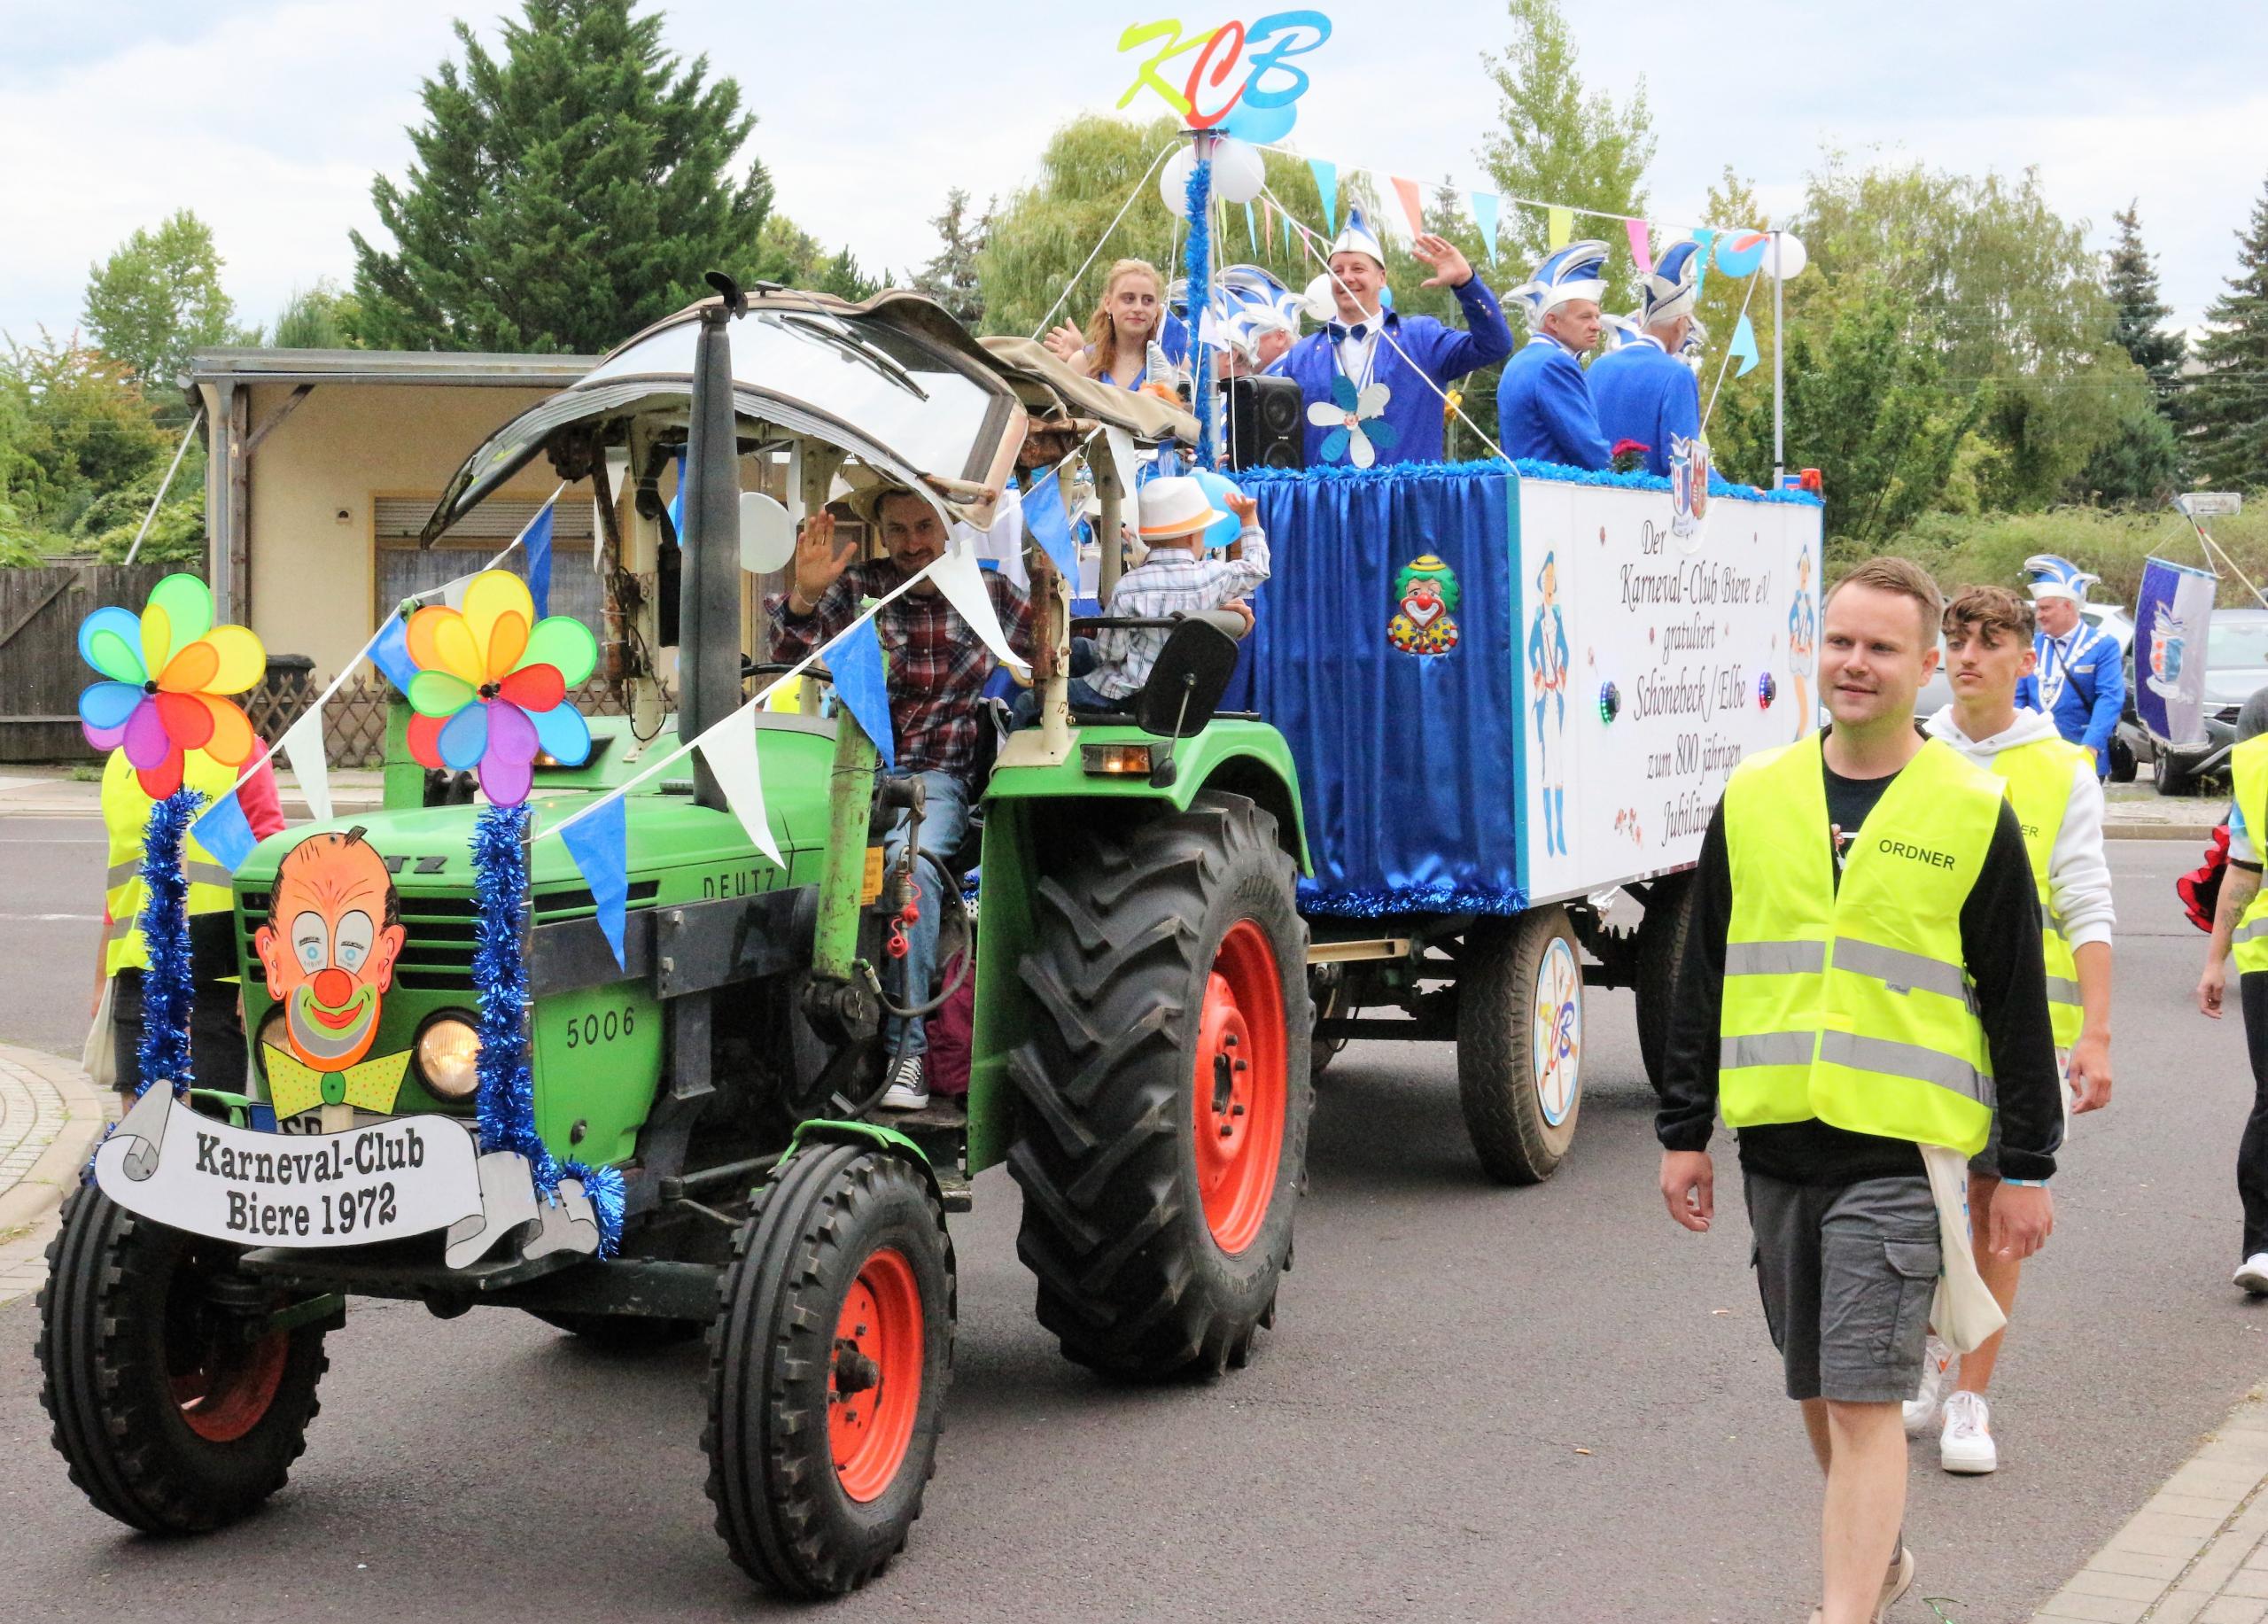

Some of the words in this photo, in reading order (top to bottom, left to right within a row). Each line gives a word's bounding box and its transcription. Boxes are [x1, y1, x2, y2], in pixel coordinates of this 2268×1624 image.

[1116, 10, 1332, 129] KCB
[1642, 519, 1666, 555] Der
[1620, 559, 1718, 612] Karneval-Club
[1721, 566, 1751, 604] Biere
[1662, 611, 1716, 664] gratuliert
[1647, 751, 1672, 780] zum
[1675, 733, 1698, 776] 800
[1699, 732, 1742, 786] jährigen
[1879, 839, 1955, 871] ORDNER
[703, 867, 775, 899] DEUTZ
[566, 1006, 635, 1049] 5006
[195, 1127, 424, 1185] Karneval-Club
[226, 1190, 310, 1236] Biere
[322, 1181, 397, 1235] 1972
